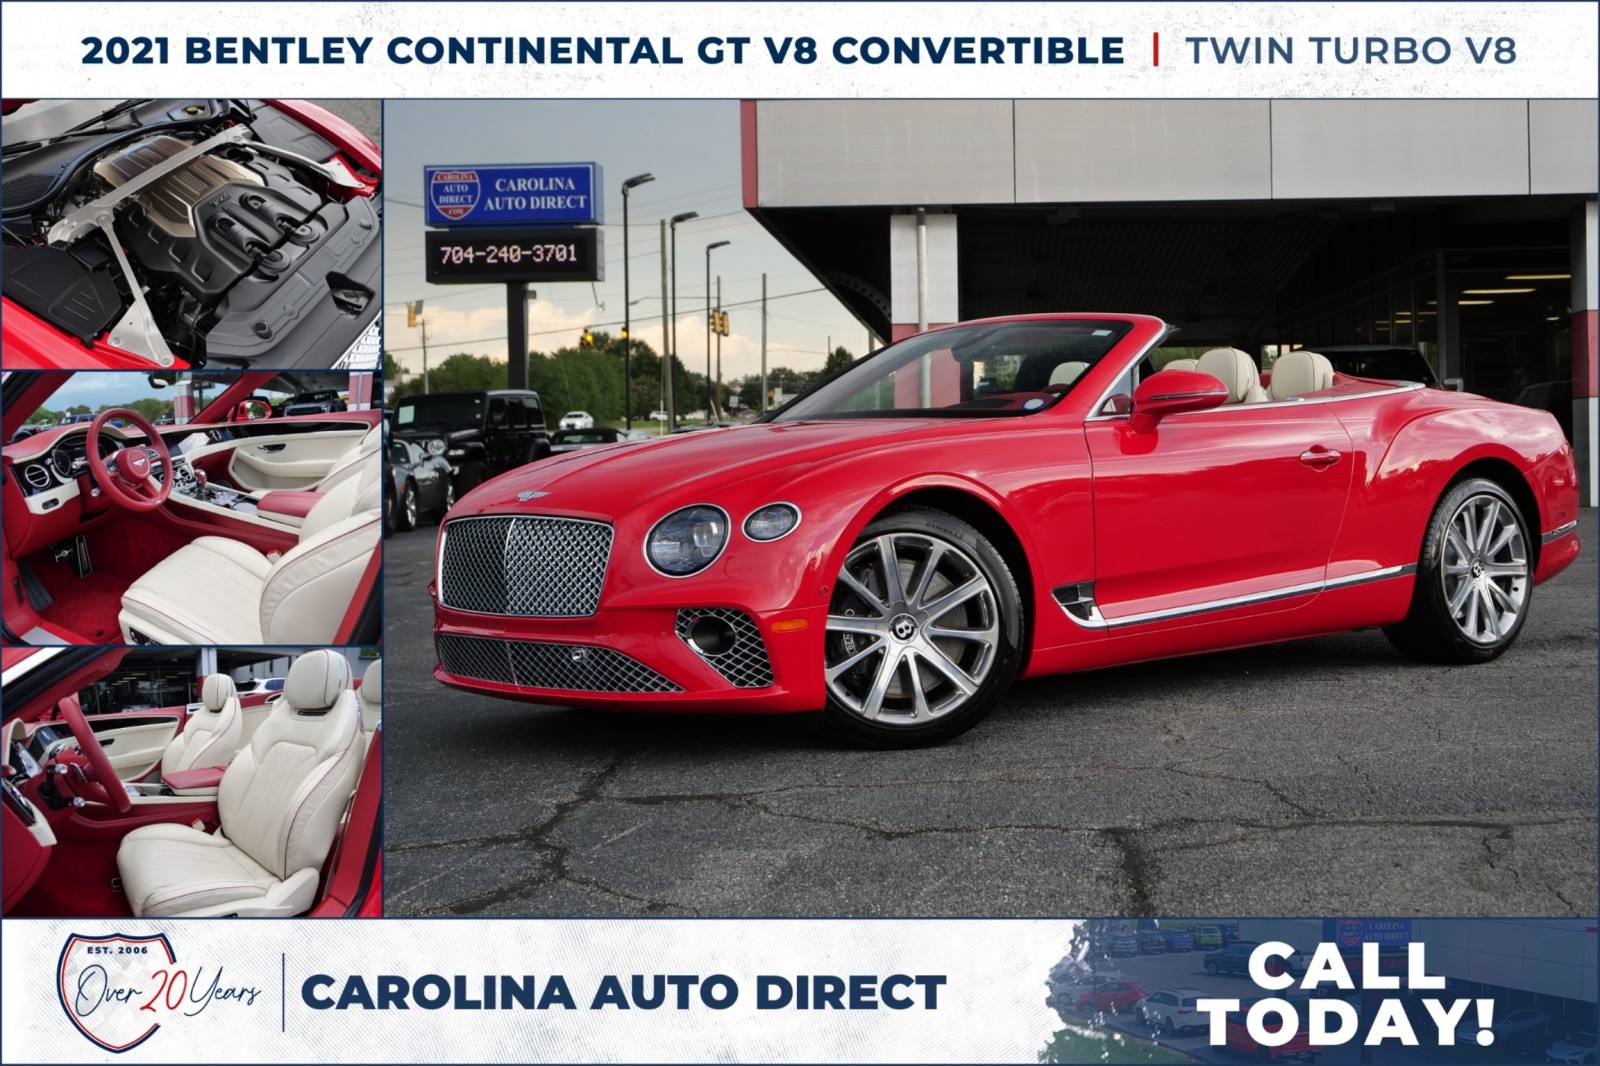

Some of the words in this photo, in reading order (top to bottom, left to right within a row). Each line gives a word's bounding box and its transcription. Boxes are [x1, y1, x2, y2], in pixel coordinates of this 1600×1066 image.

[437, 173, 474, 181] CAROLINA
[443, 184, 469, 194] AUTO
[495, 177, 576, 193] CAROLINA
[439, 194, 473, 205] DIRECT
[484, 196, 526, 211] AUTO
[529, 194, 587, 210] DIRECT
[440, 244, 577, 264] 704-240-3701
